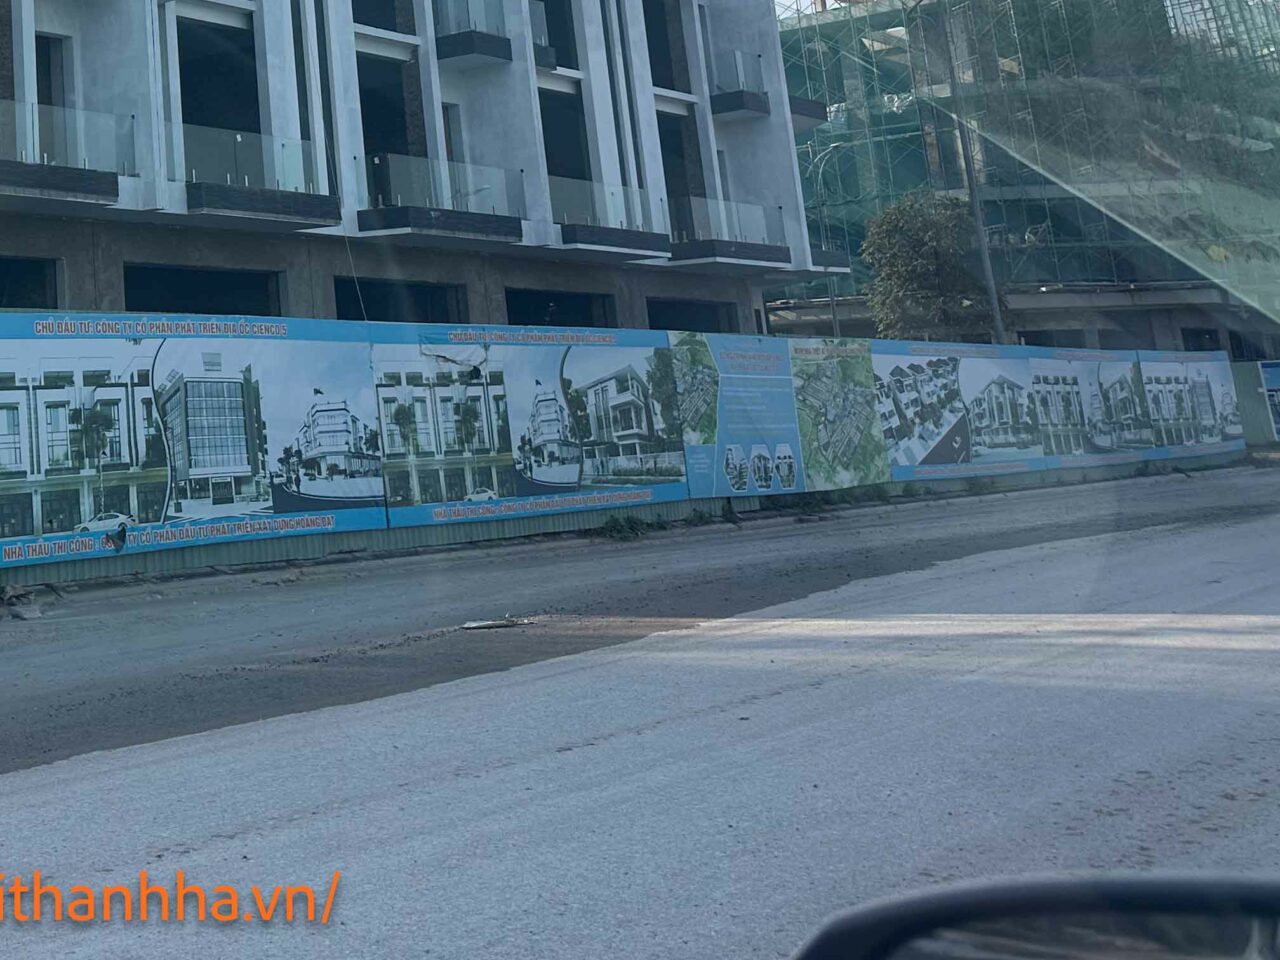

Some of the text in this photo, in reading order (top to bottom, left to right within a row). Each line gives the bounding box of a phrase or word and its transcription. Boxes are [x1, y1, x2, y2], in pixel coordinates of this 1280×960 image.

[34, 316, 55, 335] CHỦ
[95, 318, 121, 336] CÔNG
[3, 542, 24, 561] NHÀ
